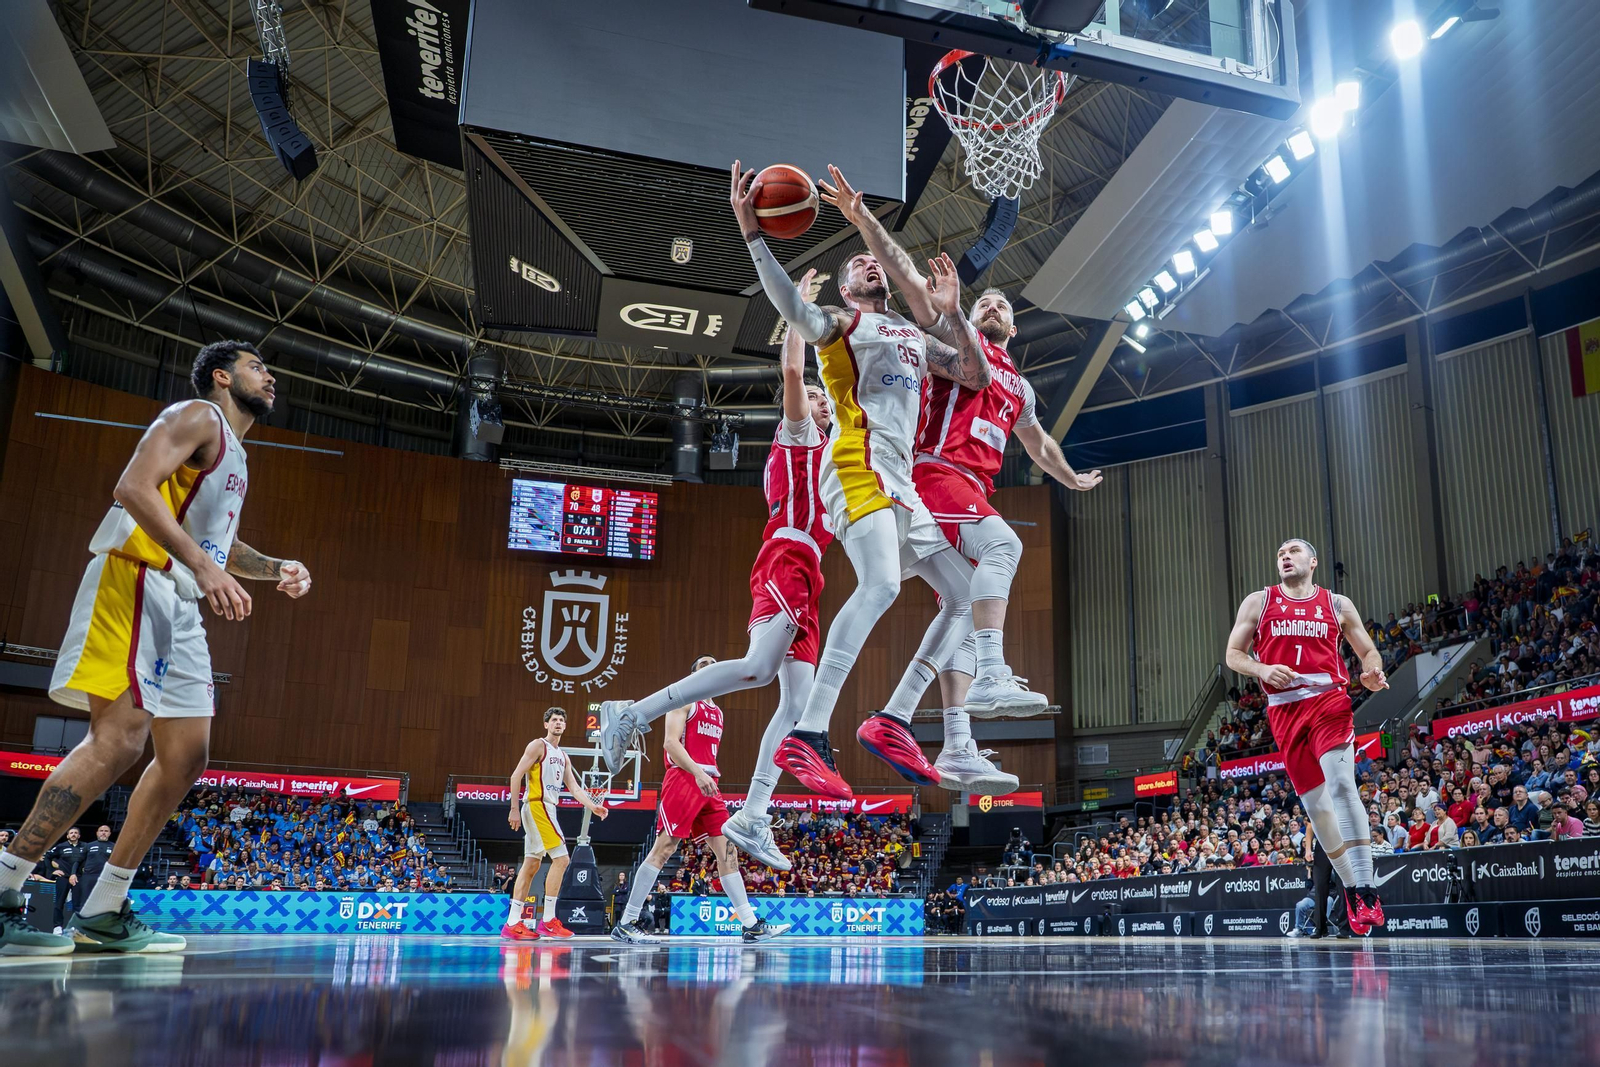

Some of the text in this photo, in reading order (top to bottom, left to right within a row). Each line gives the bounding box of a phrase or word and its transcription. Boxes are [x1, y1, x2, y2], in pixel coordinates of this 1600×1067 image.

[441, 18, 457, 105] despierta emociones
[897, 343, 920, 368] 35
[569, 502, 601, 513] 70 48
[573, 525, 595, 536] 07:41
[521, 606, 630, 694] CABILDO DE TENERIFE
[1295, 644, 1303, 666] 7
[1447, 718, 1493, 738] endesa
[1569, 692, 1600, 712] tene
[1384, 736, 1391, 747] B
[555, 770, 561, 781] 5
[1221, 763, 1253, 780] endesa
[291, 780, 339, 794] tenerife!
[456, 789, 499, 801] endesa
[993, 799, 1014, 807] STORE
[1490, 861, 1538, 878] CaixaBank
[1553, 849, 1600, 872] teneri
[1555, 869, 1582, 879] despierta
[1130, 879, 1192, 898] CaixaBank tenerife!
[1224, 877, 1261, 893] endesa
[986, 895, 1010, 907] endesa
[1091, 887, 1118, 901] endesa
[357, 902, 408, 919] DXT
[846, 907, 887, 923] DXT
[357, 921, 402, 930] TENERIFE
[846, 924, 882, 932] TENERIFE
[1131, 921, 1165, 932] #LaFamilia
[1386, 916, 1449, 932] #LaFamilia
[1573, 923, 1584, 932] DE
